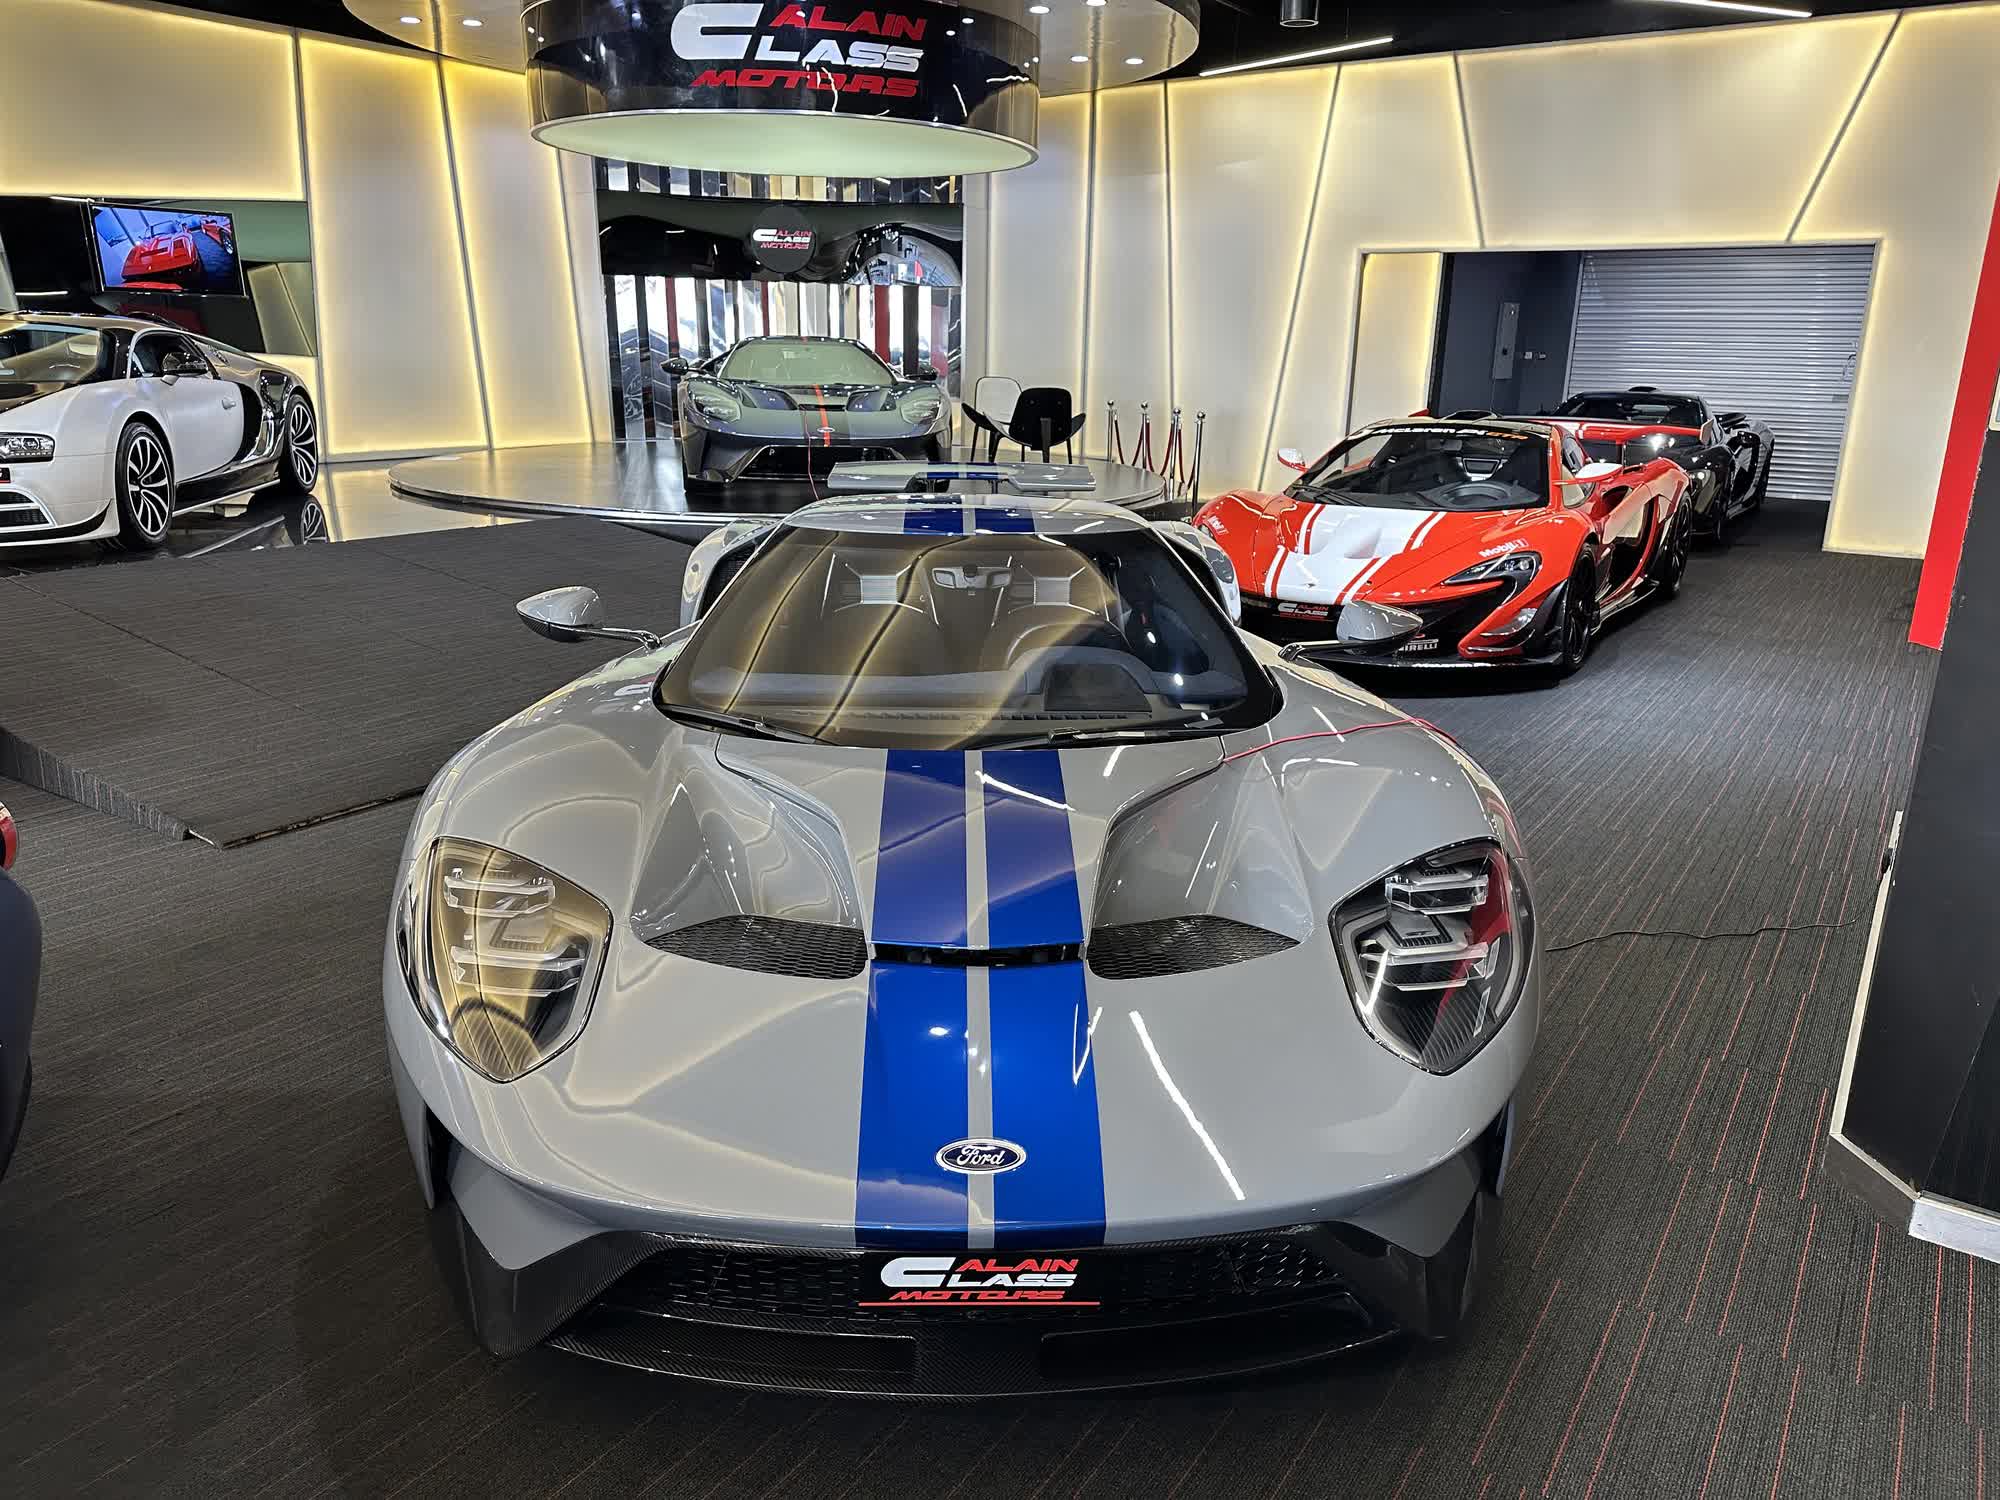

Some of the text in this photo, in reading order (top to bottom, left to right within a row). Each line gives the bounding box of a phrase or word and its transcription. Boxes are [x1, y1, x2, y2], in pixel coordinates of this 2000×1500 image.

[769, 5, 928, 41] ALAIN
[670, 3, 924, 73] CLASS
[690, 68, 919, 97] MOTORS
[956, 1144, 1005, 1165] Ford
[880, 1256, 1078, 1288] CLASS
[955, 1258, 1079, 1272] ALAIN
[888, 1290, 1066, 1301] MOTORS
